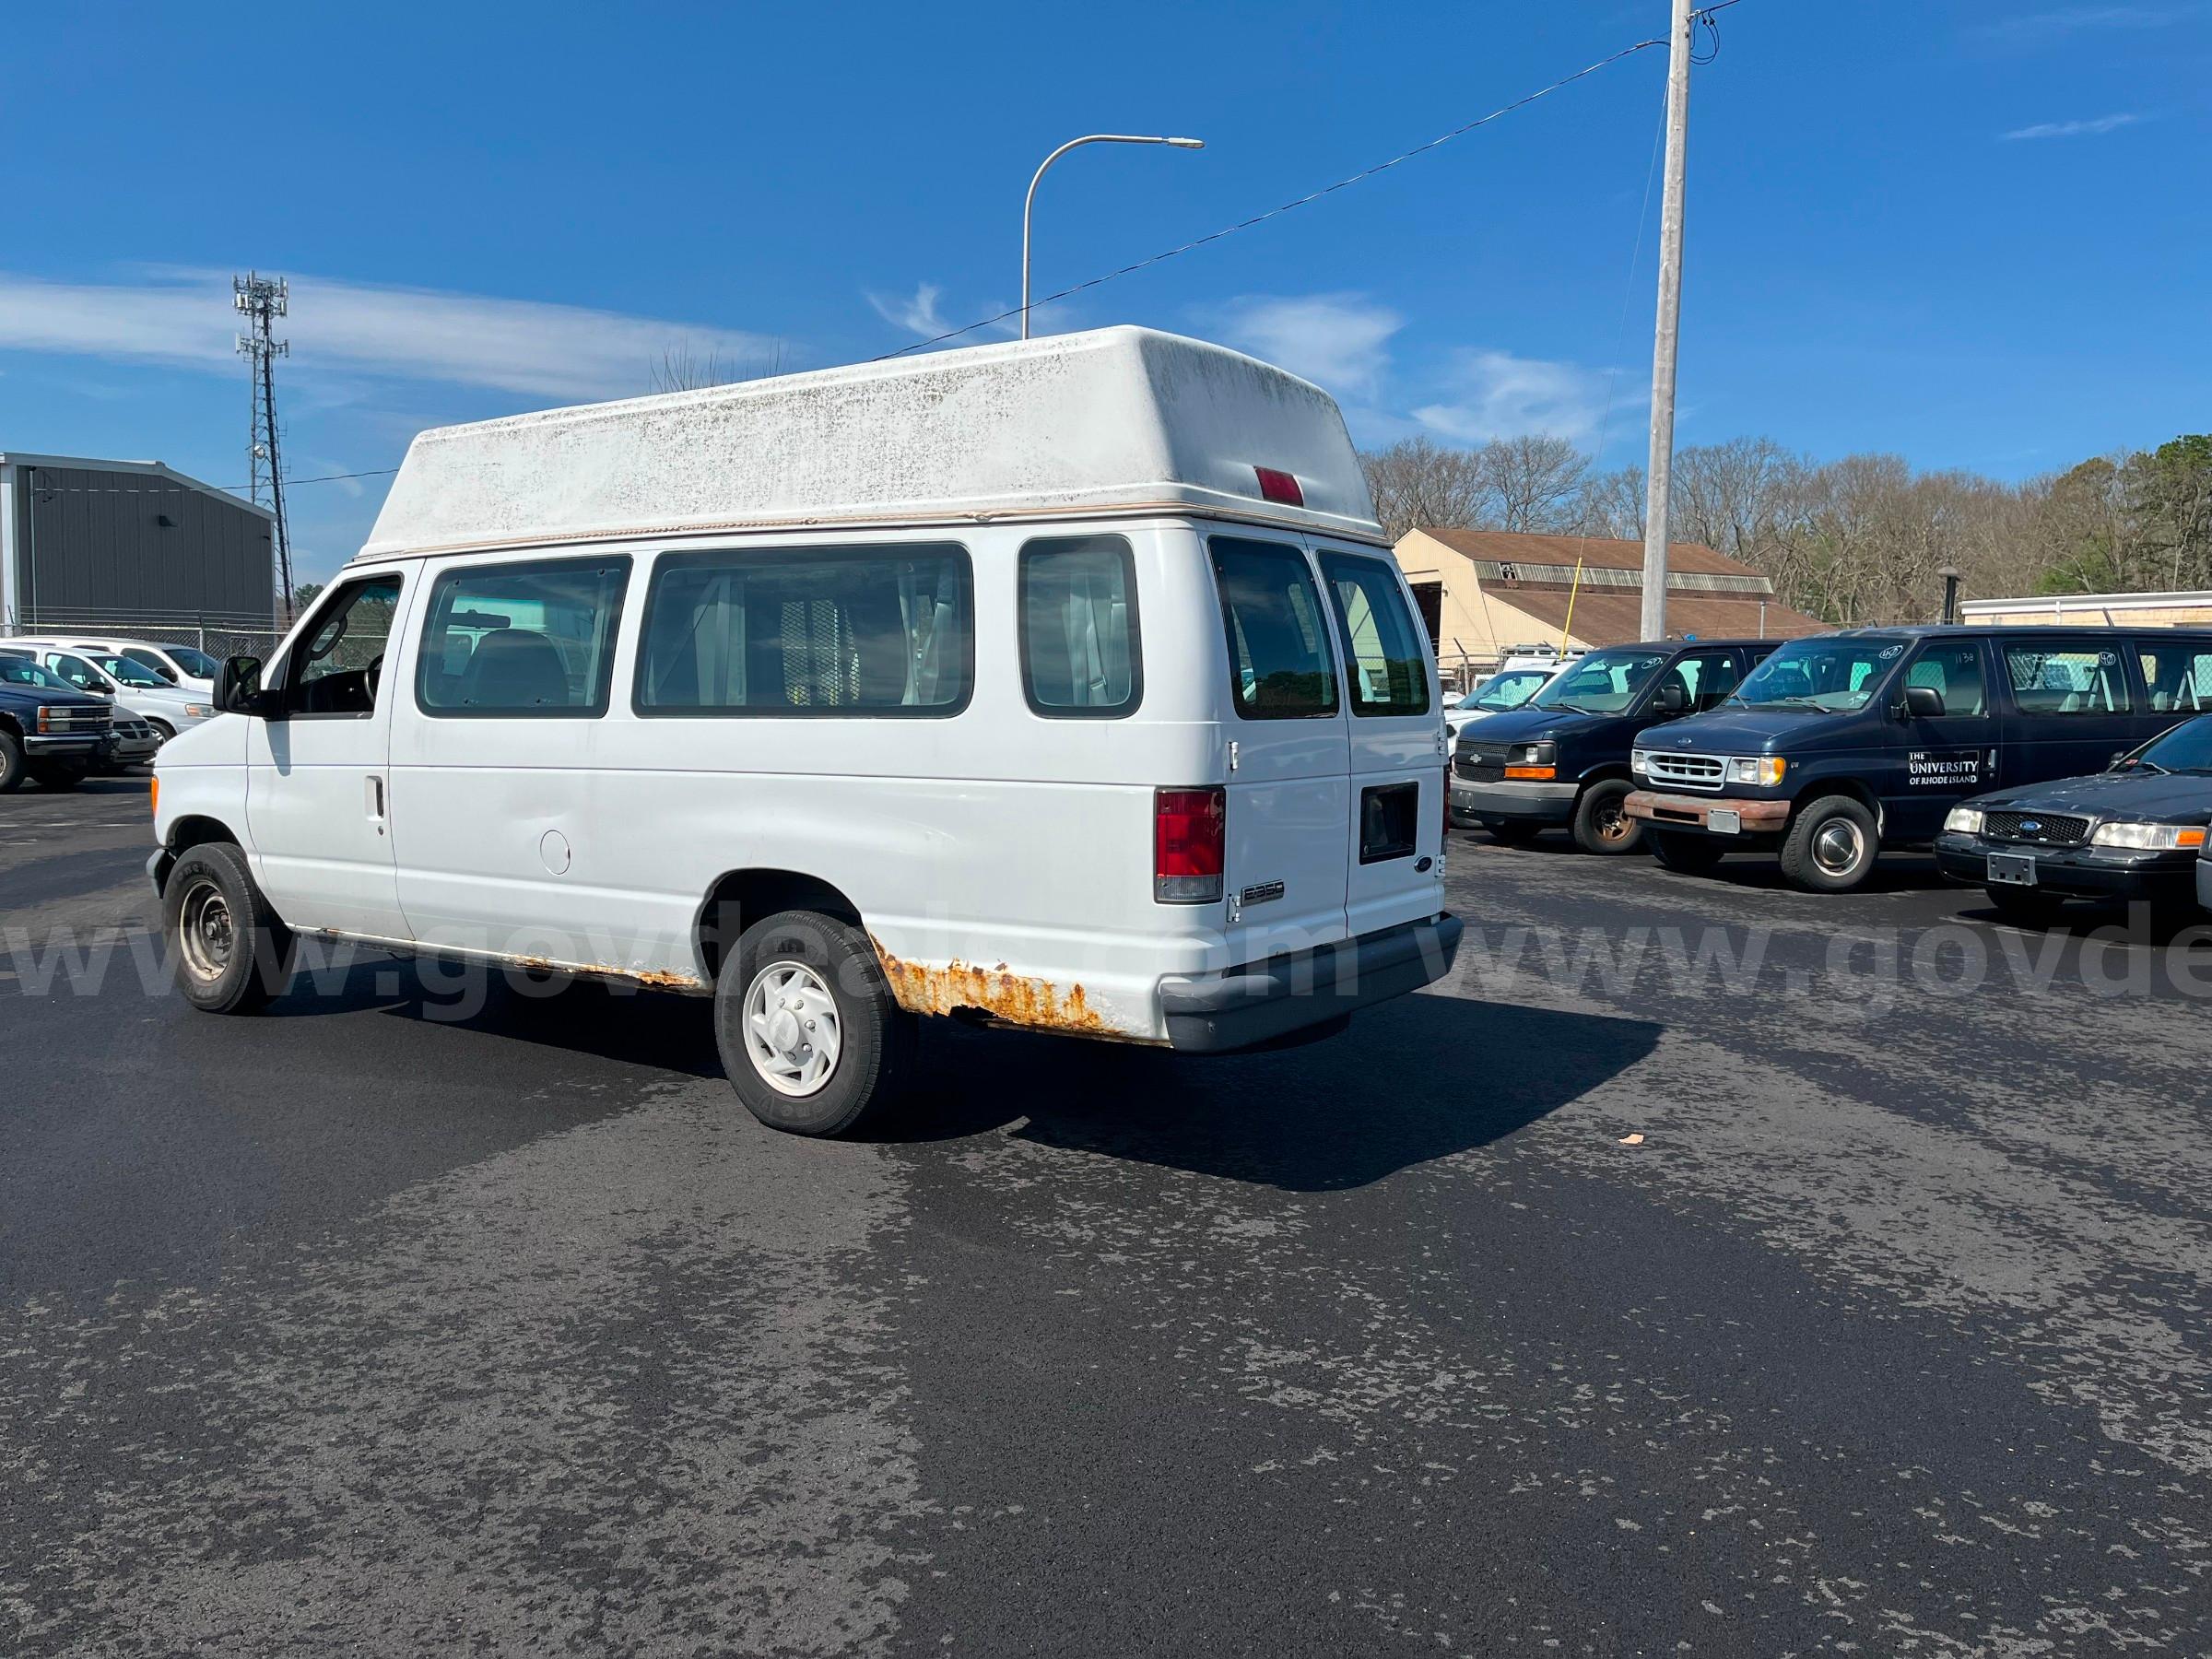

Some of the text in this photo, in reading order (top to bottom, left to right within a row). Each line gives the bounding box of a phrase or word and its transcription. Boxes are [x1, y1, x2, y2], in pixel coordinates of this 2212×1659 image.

[1910, 752, 1925, 760] THE
[1910, 761, 1979, 774] UNIVERSITY
[1910, 775, 1977, 785] OF RHODE ISLAND
